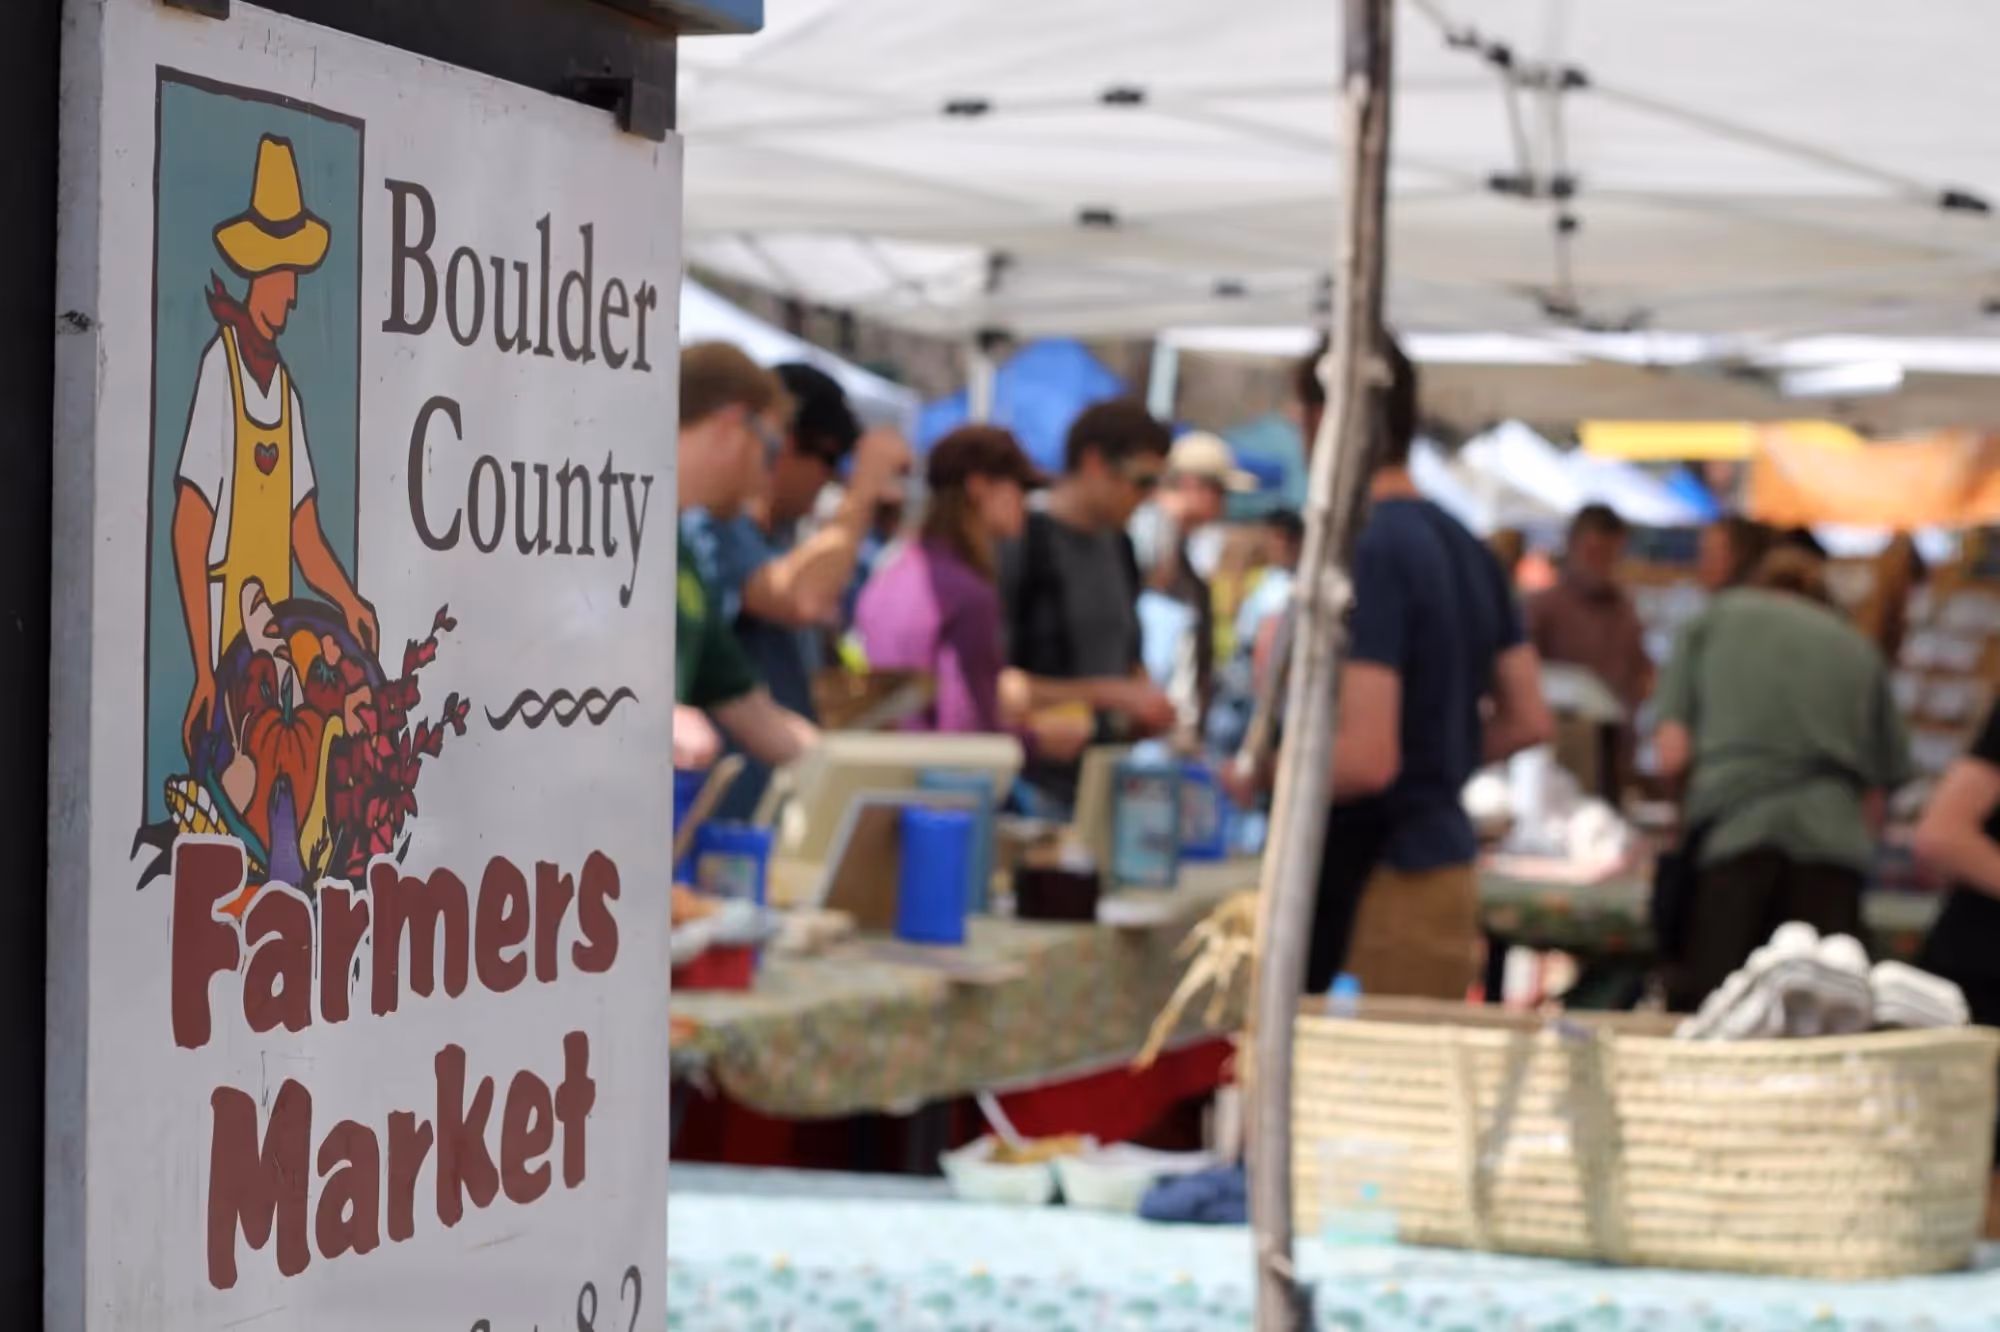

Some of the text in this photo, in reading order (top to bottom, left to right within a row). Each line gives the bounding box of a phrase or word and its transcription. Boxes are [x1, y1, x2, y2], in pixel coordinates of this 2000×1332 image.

[381, 178, 657, 373] Boulder
[408, 395, 654, 608] County
[171, 842, 621, 1050] Farmers
[207, 1030, 597, 1290] Market
